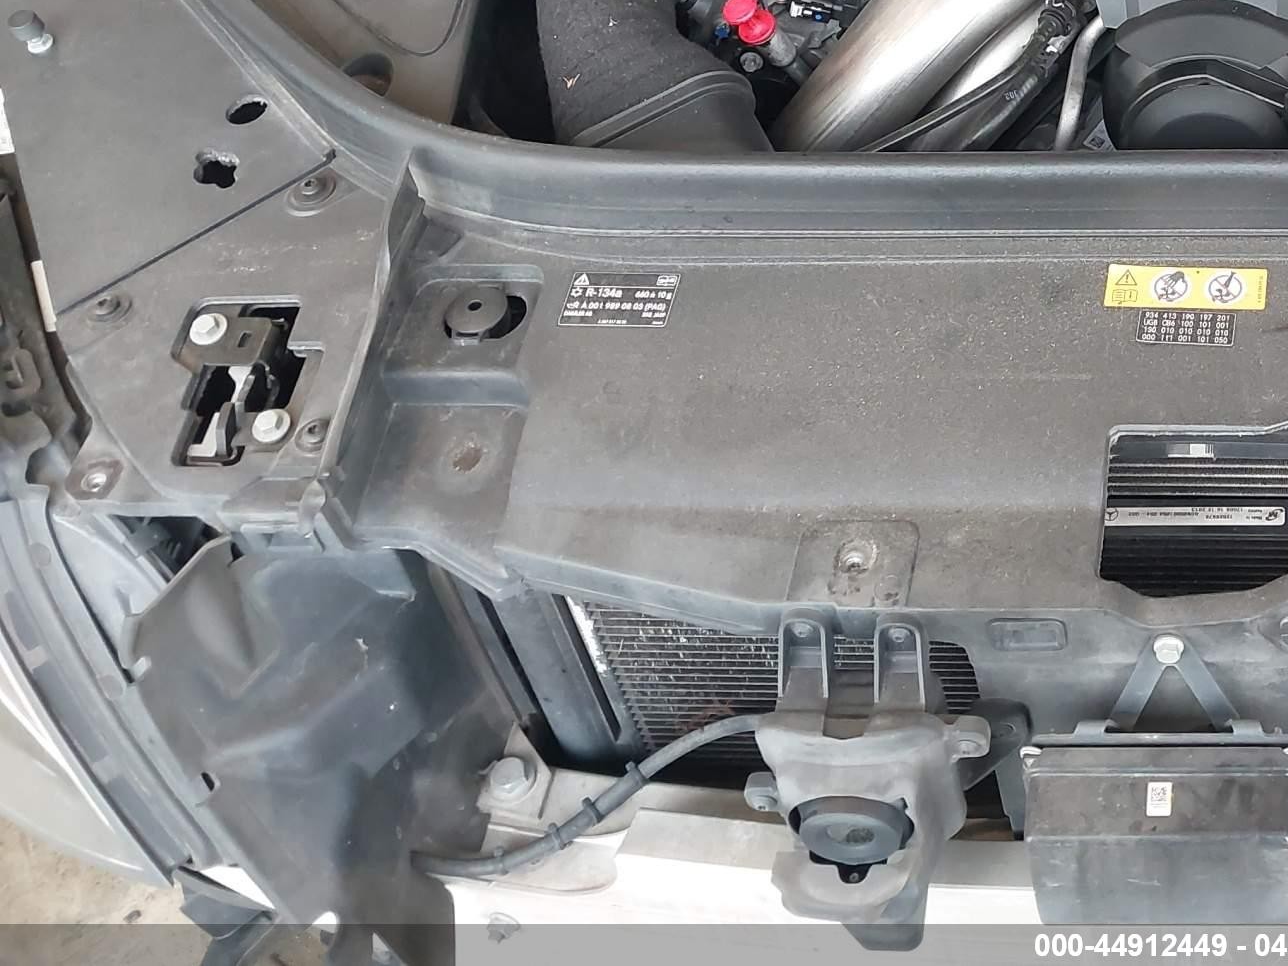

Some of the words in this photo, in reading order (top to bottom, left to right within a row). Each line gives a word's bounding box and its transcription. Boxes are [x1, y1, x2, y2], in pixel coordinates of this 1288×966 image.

[585, 287, 623, 298] R-134a
[1162, 312, 1177, 320] 413
[1216, 314, 1230, 322] 201
[1181, 320, 1194, 328] 100
[1215, 321, 1229, 329] 001
[1196, 328, 1211, 336] 010
[1141, 333, 1156, 341] 000
[1197, 335, 1209, 343] 101
